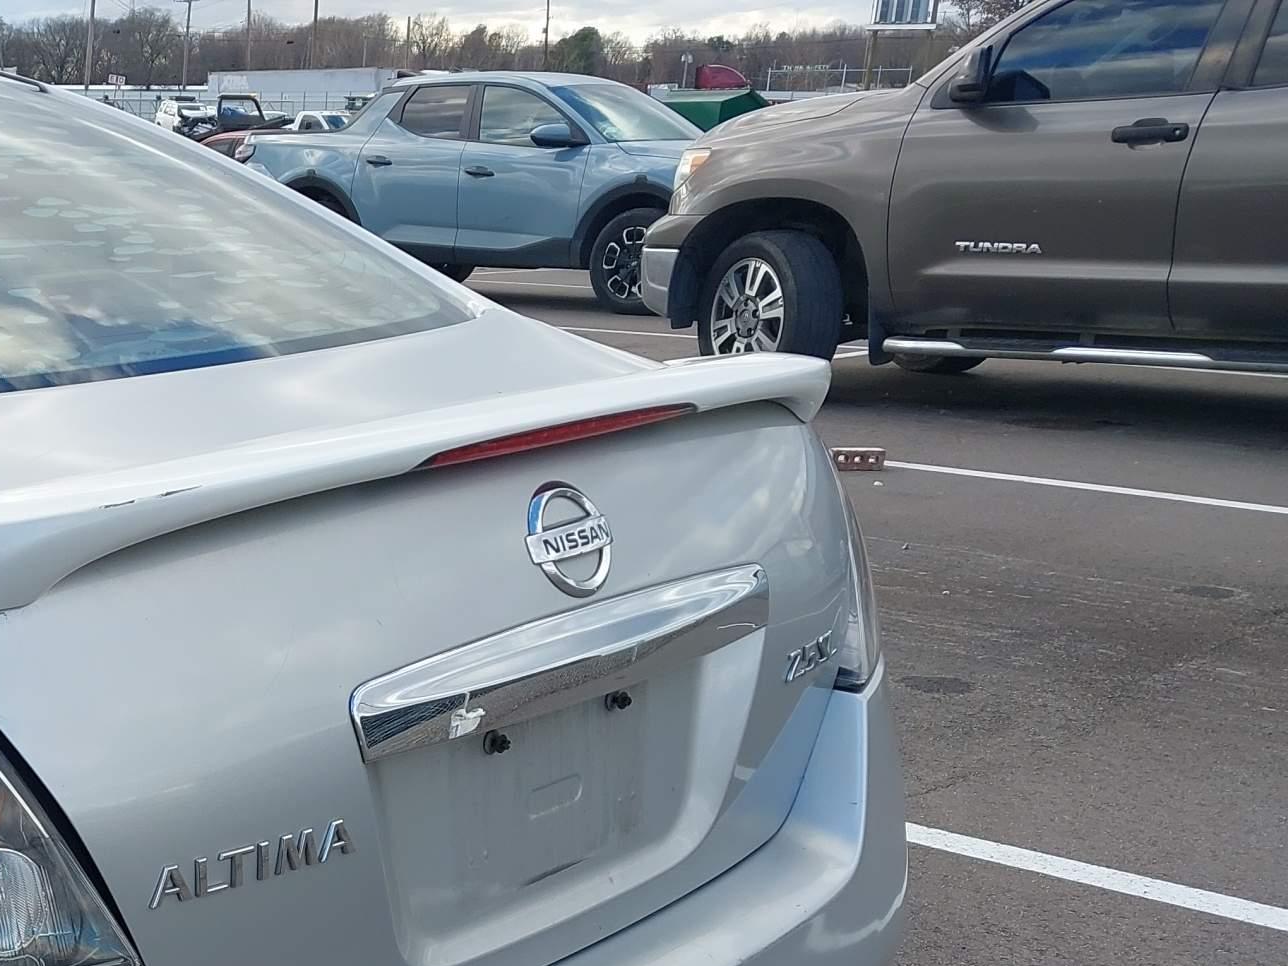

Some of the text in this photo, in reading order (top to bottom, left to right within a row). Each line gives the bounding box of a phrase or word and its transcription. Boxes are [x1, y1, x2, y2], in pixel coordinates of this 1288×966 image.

[955, 241, 1042, 254] TUNDRA
[542, 522, 610, 556] NISSAN
[148, 818, 355, 909] ALTIMA
